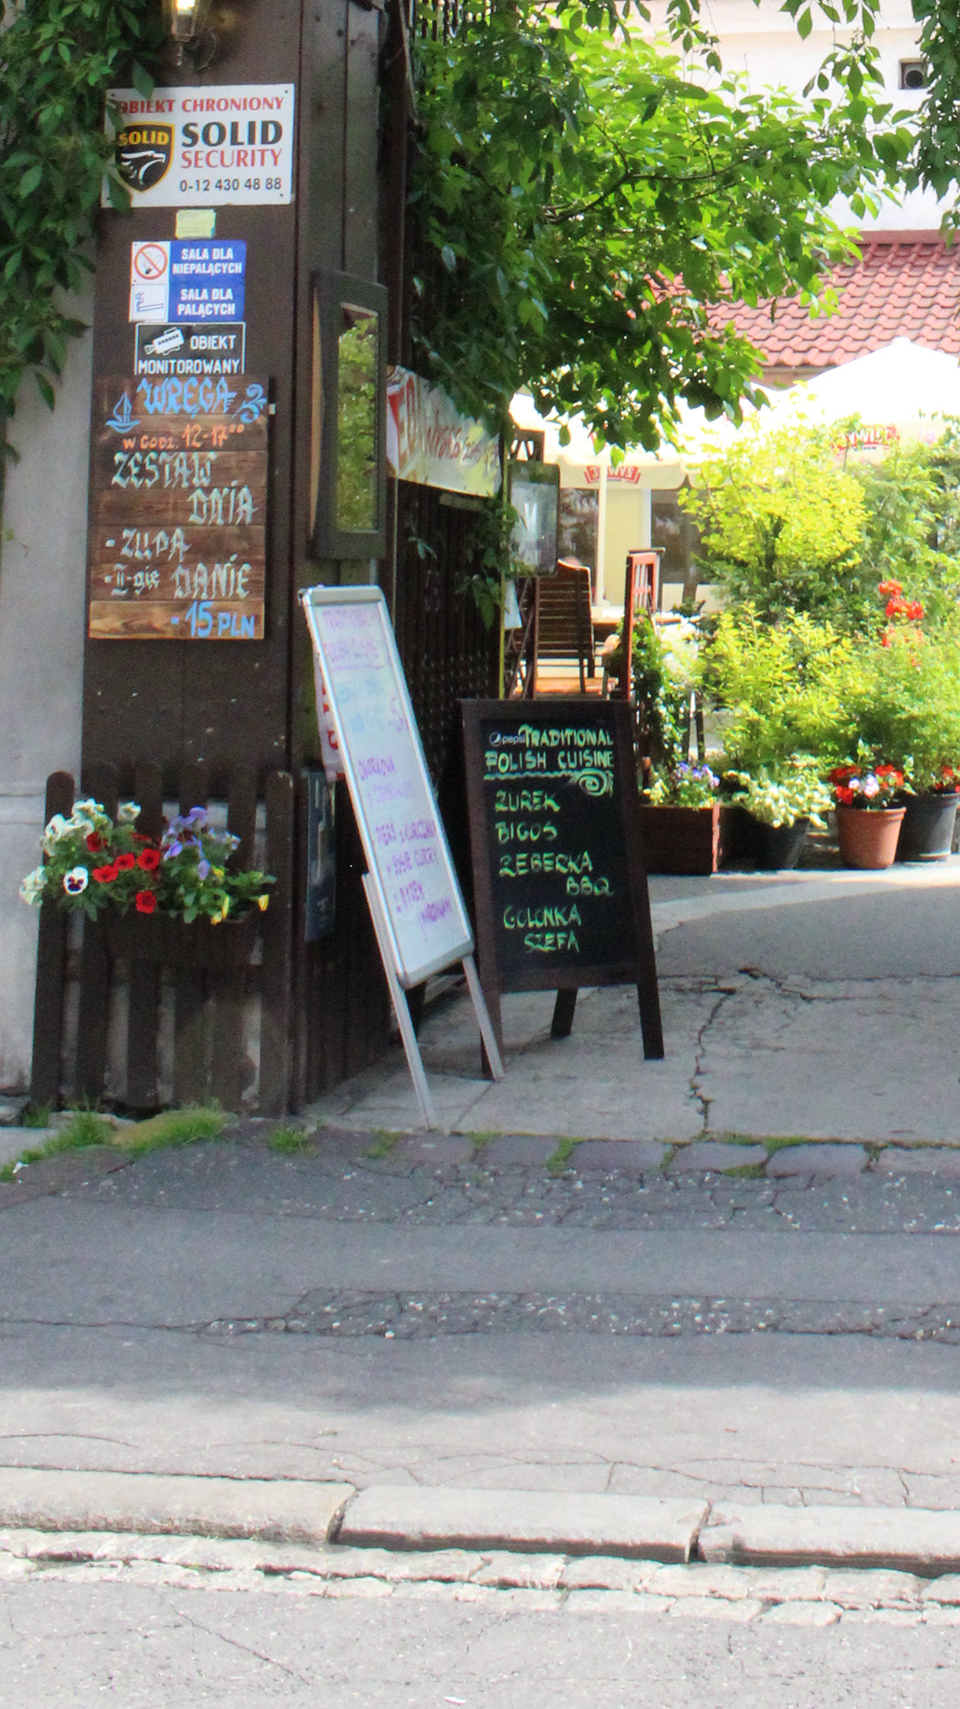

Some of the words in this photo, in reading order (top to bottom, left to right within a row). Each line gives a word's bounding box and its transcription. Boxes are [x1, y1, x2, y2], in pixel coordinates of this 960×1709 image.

[181, 96, 285, 113] CHRONIONY
[118, 129, 169, 146] SOLID
[181, 120, 283, 148] SOLID
[181, 148, 282, 169] SECURITY
[179, 179, 210, 192] 0-12
[215, 178, 240, 191] 430
[244, 178, 260, 190] 48
[265, 177, 282, 190] 88
[181, 248, 209, 260] SALA
[212, 248, 234, 260] DLA
[172, 262, 242, 276] NIEPALĄCYCH
[180, 288, 208, 300] SALA
[211, 288, 233, 300] DLA
[177, 303, 236, 318] PALĄCYCH
[190, 334, 236, 350] OBIEKT
[138, 359, 240, 374] MONITOROWANY
[111, 451, 218, 489] ZESTAW
[120, 527, 192, 562] ZUPA
[185, 600, 214, 638] 15
[218, 612, 255, 638] PLN
[518, 723, 613, 747] TRADITIONAL
[484, 750, 546, 773] POLISH
[557, 748, 614, 769] CUISINE
[495, 821, 558, 844] BIGOS
[566, 875, 614, 896] BBQ
[503, 903, 581, 929] GOLONKA
[524, 930, 580, 953] SZEFA
